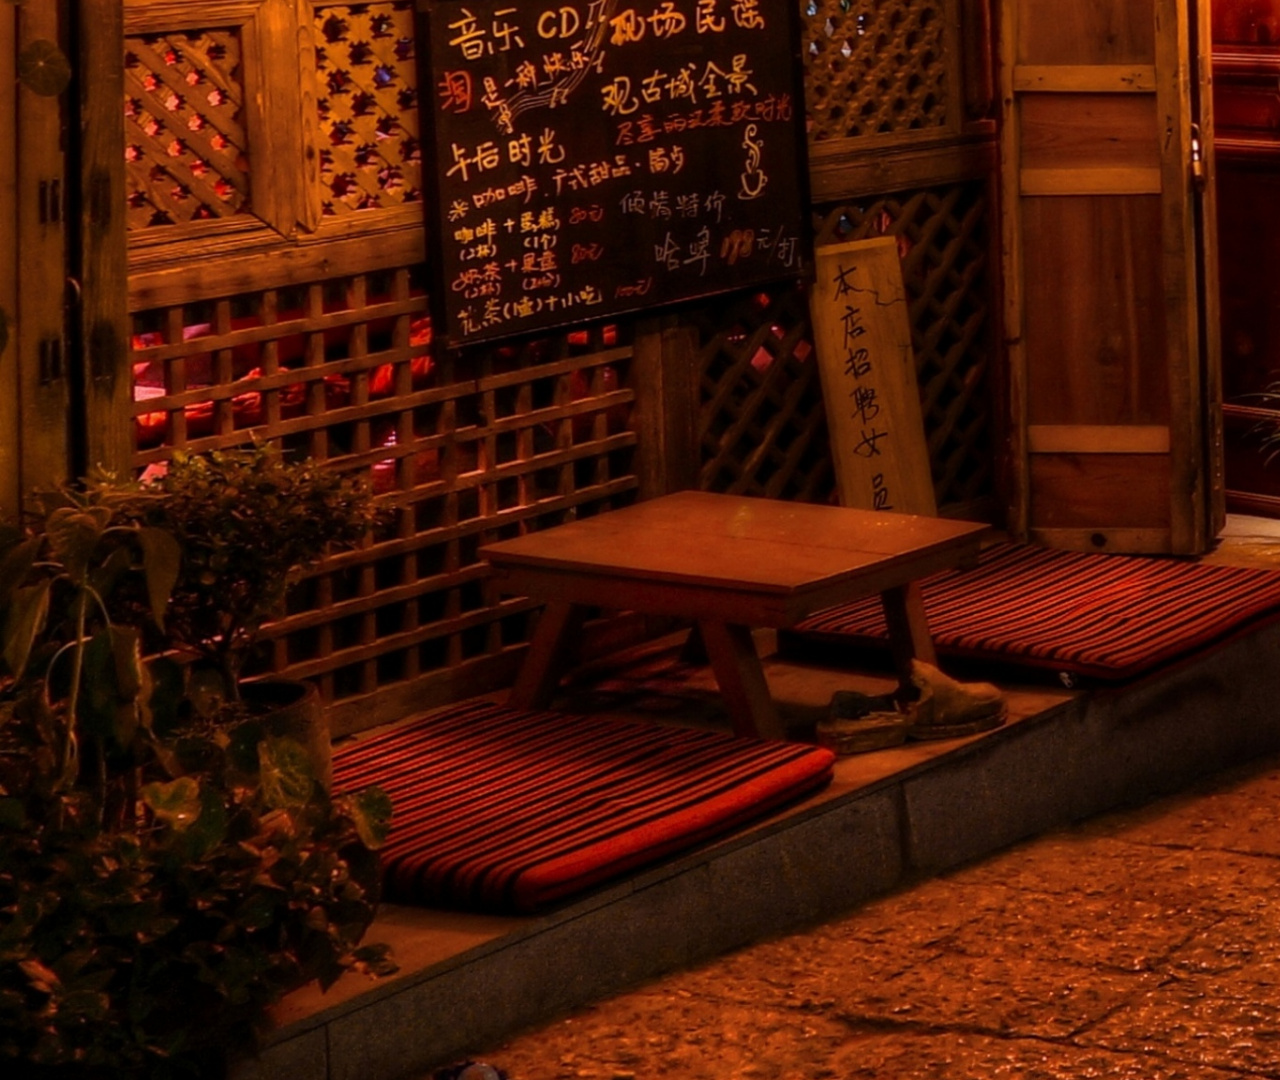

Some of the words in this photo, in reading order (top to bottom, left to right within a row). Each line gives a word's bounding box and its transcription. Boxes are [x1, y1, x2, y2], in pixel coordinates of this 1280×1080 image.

[447, 8, 525, 61] 音乐
[537, 6, 580, 39] CD
[600, 53, 758, 116] 观古城全景
[446, 127, 565, 182] 午后时光
[619, 190, 727, 224] 倾情特价
